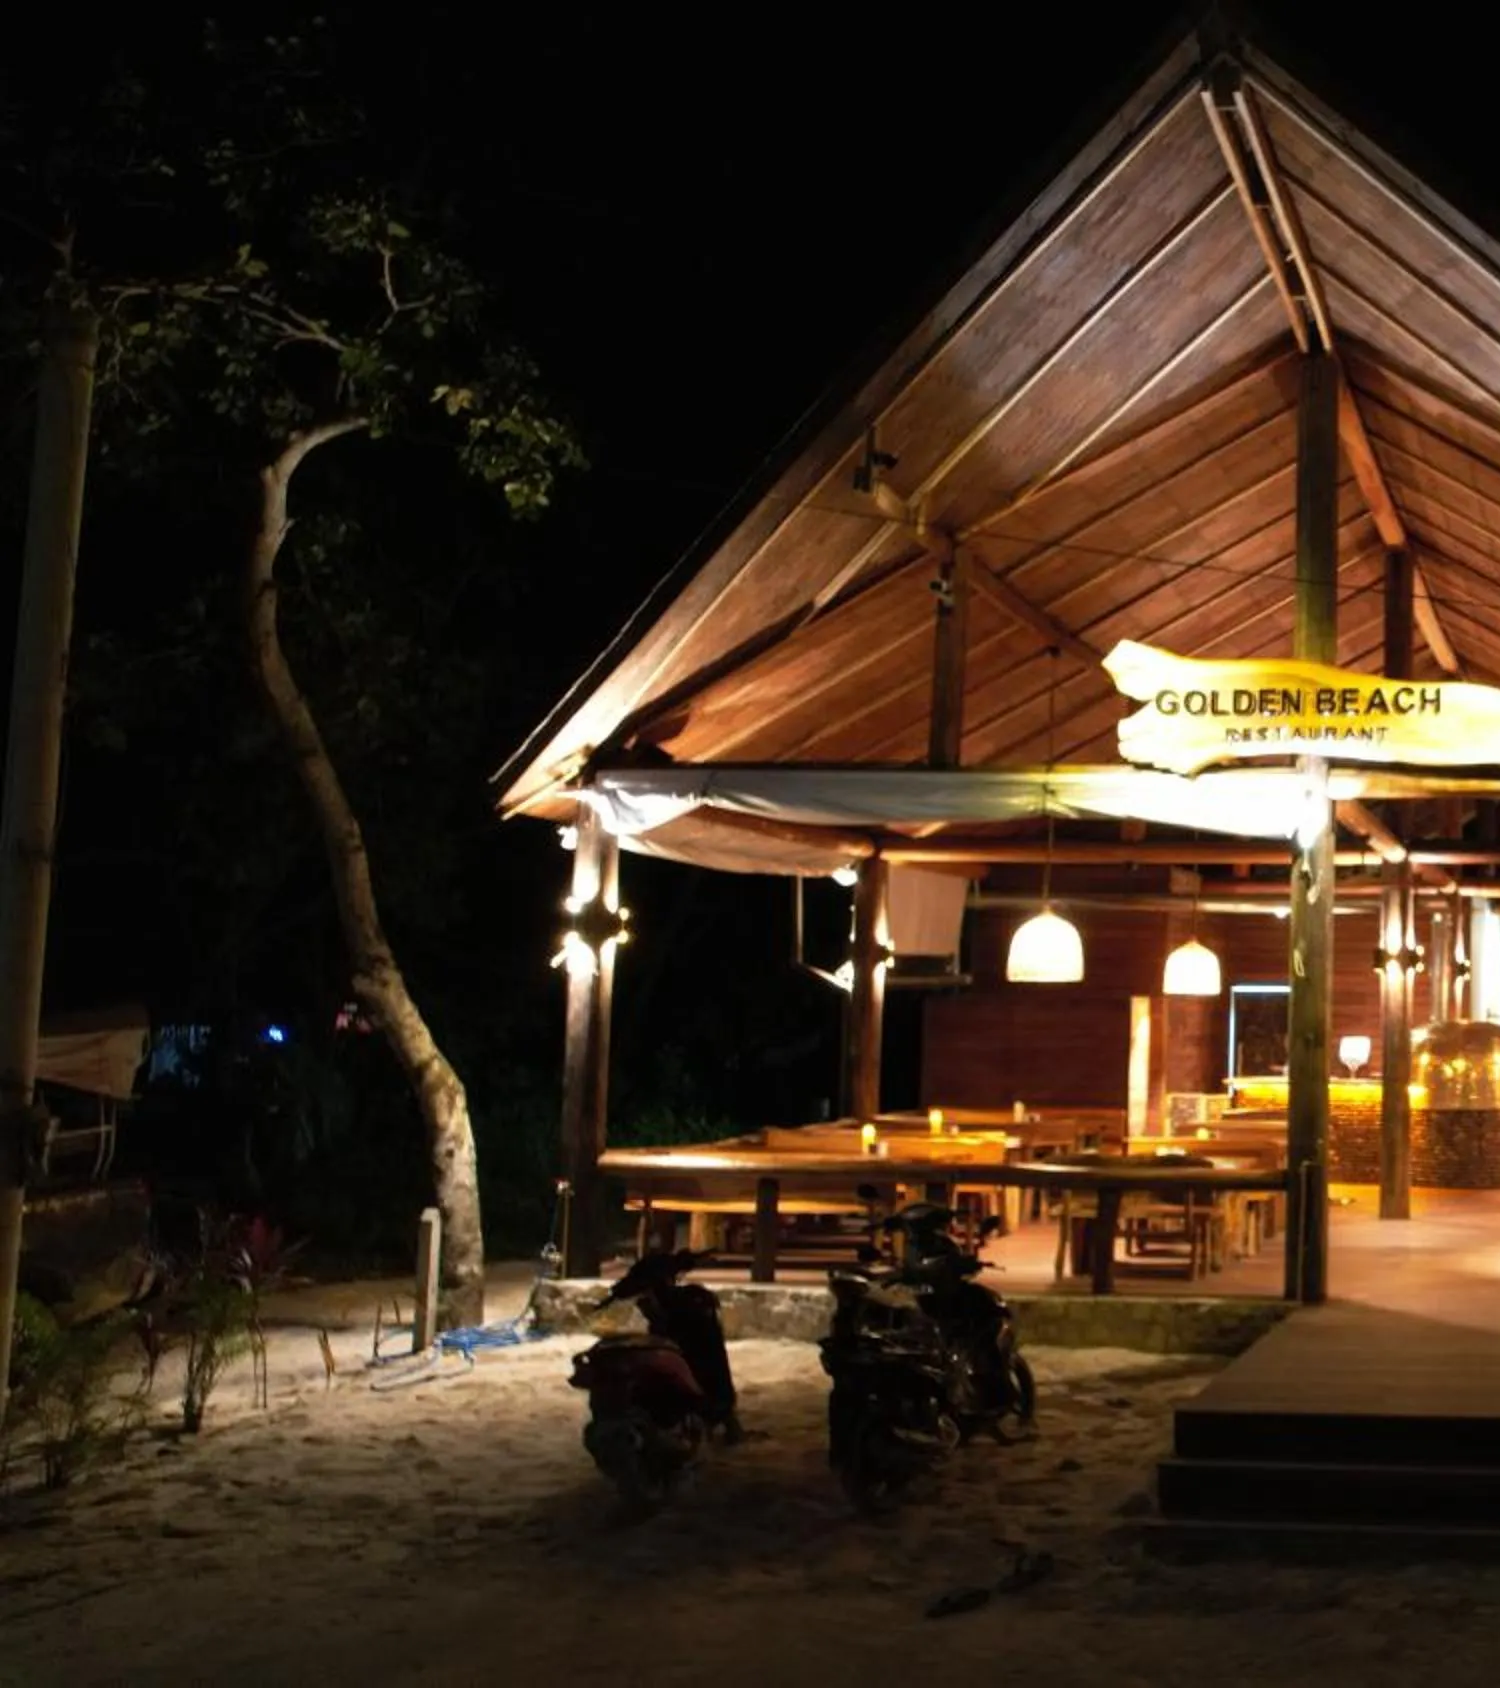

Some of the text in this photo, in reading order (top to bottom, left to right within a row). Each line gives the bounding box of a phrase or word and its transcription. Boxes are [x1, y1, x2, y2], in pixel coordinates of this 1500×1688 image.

[1155, 687, 1442, 717] GOLDEN BEACH
[1225, 727, 1389, 743] RESTAURANT
